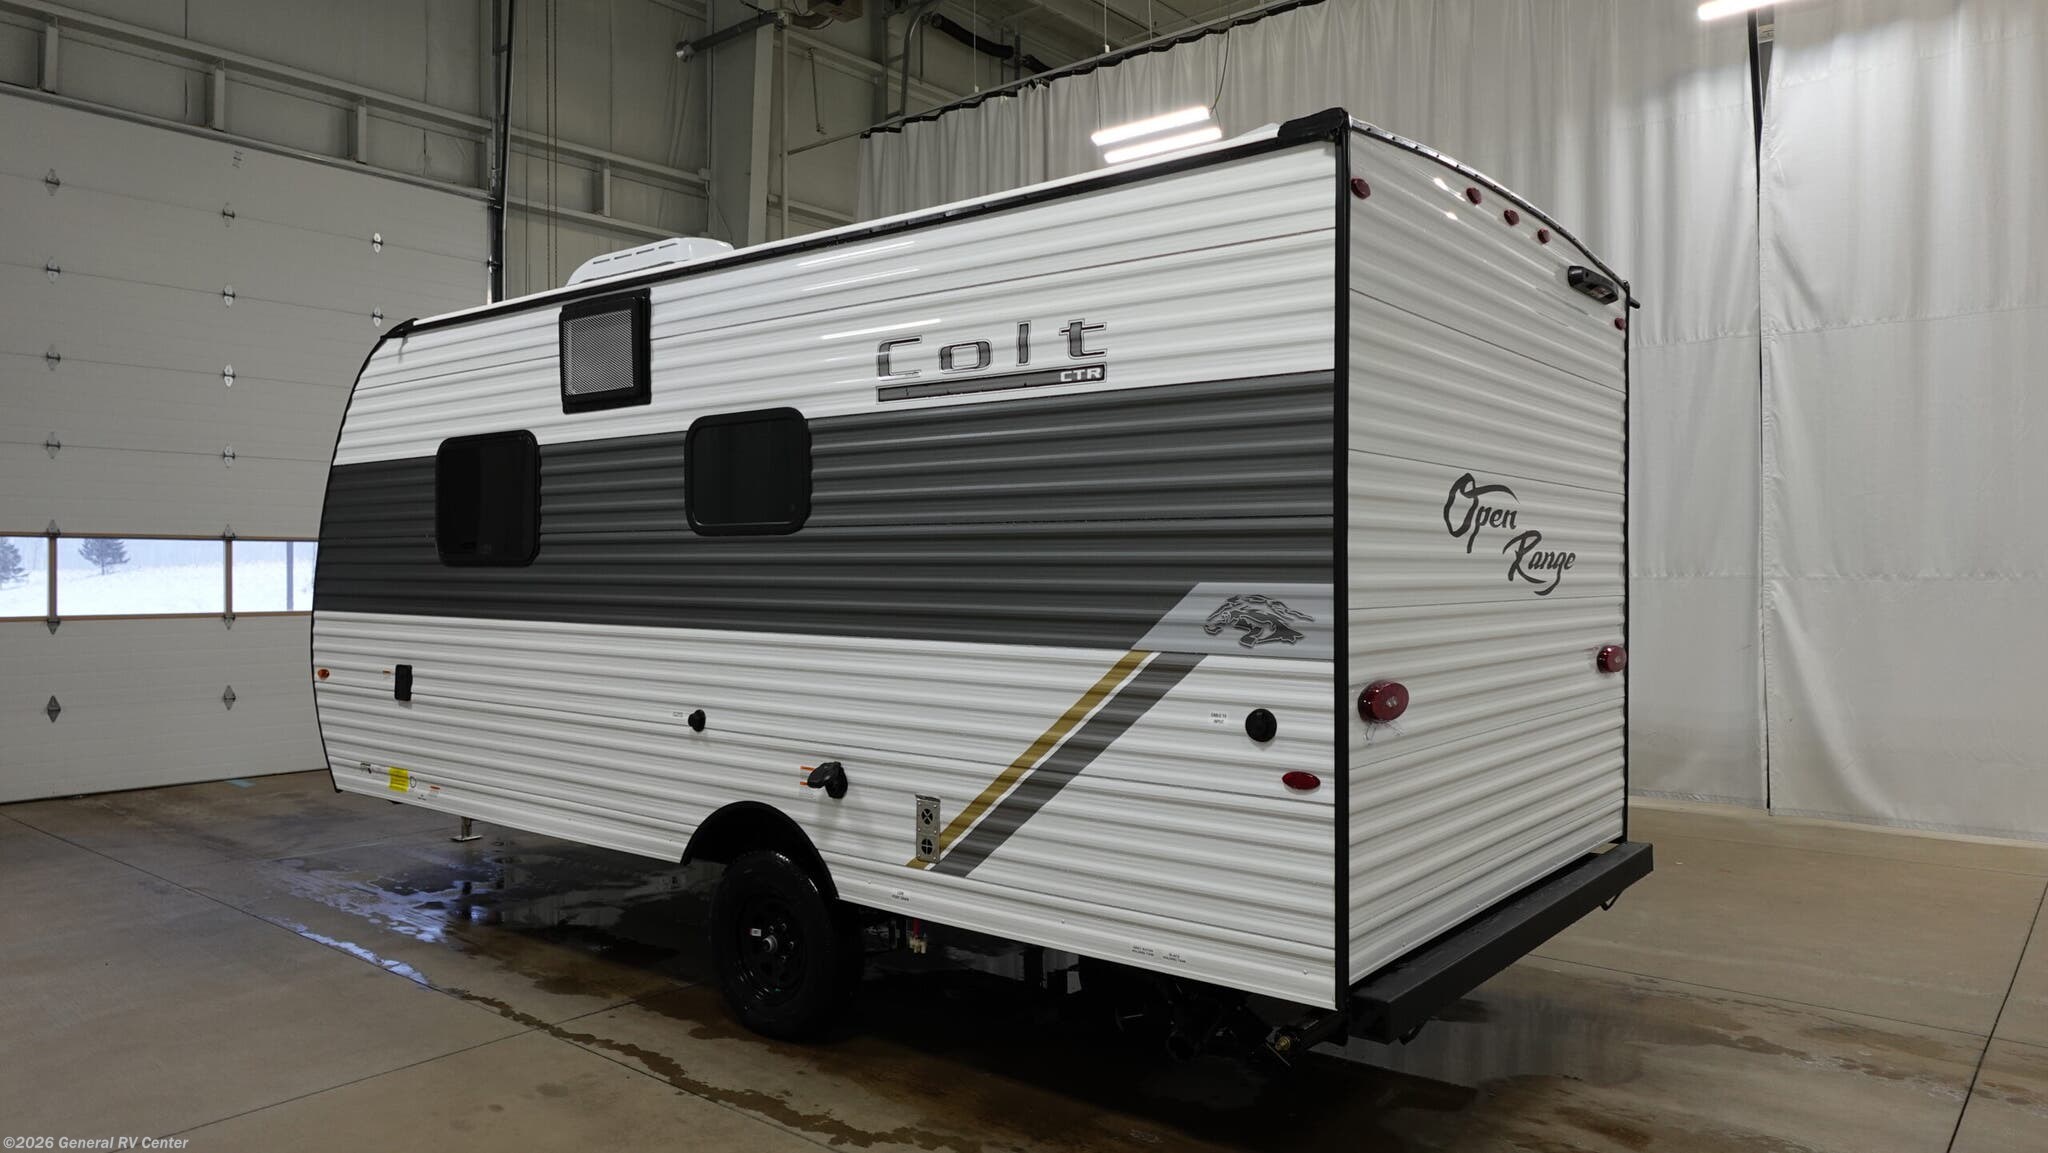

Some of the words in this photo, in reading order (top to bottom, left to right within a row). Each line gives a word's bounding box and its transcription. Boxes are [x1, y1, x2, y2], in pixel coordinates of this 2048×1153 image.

[876, 319, 1107, 381] Colt
[1060, 367, 1103, 382] CTR
[1443, 472, 1520, 554] Open
[1502, 530, 1576, 596] Range
